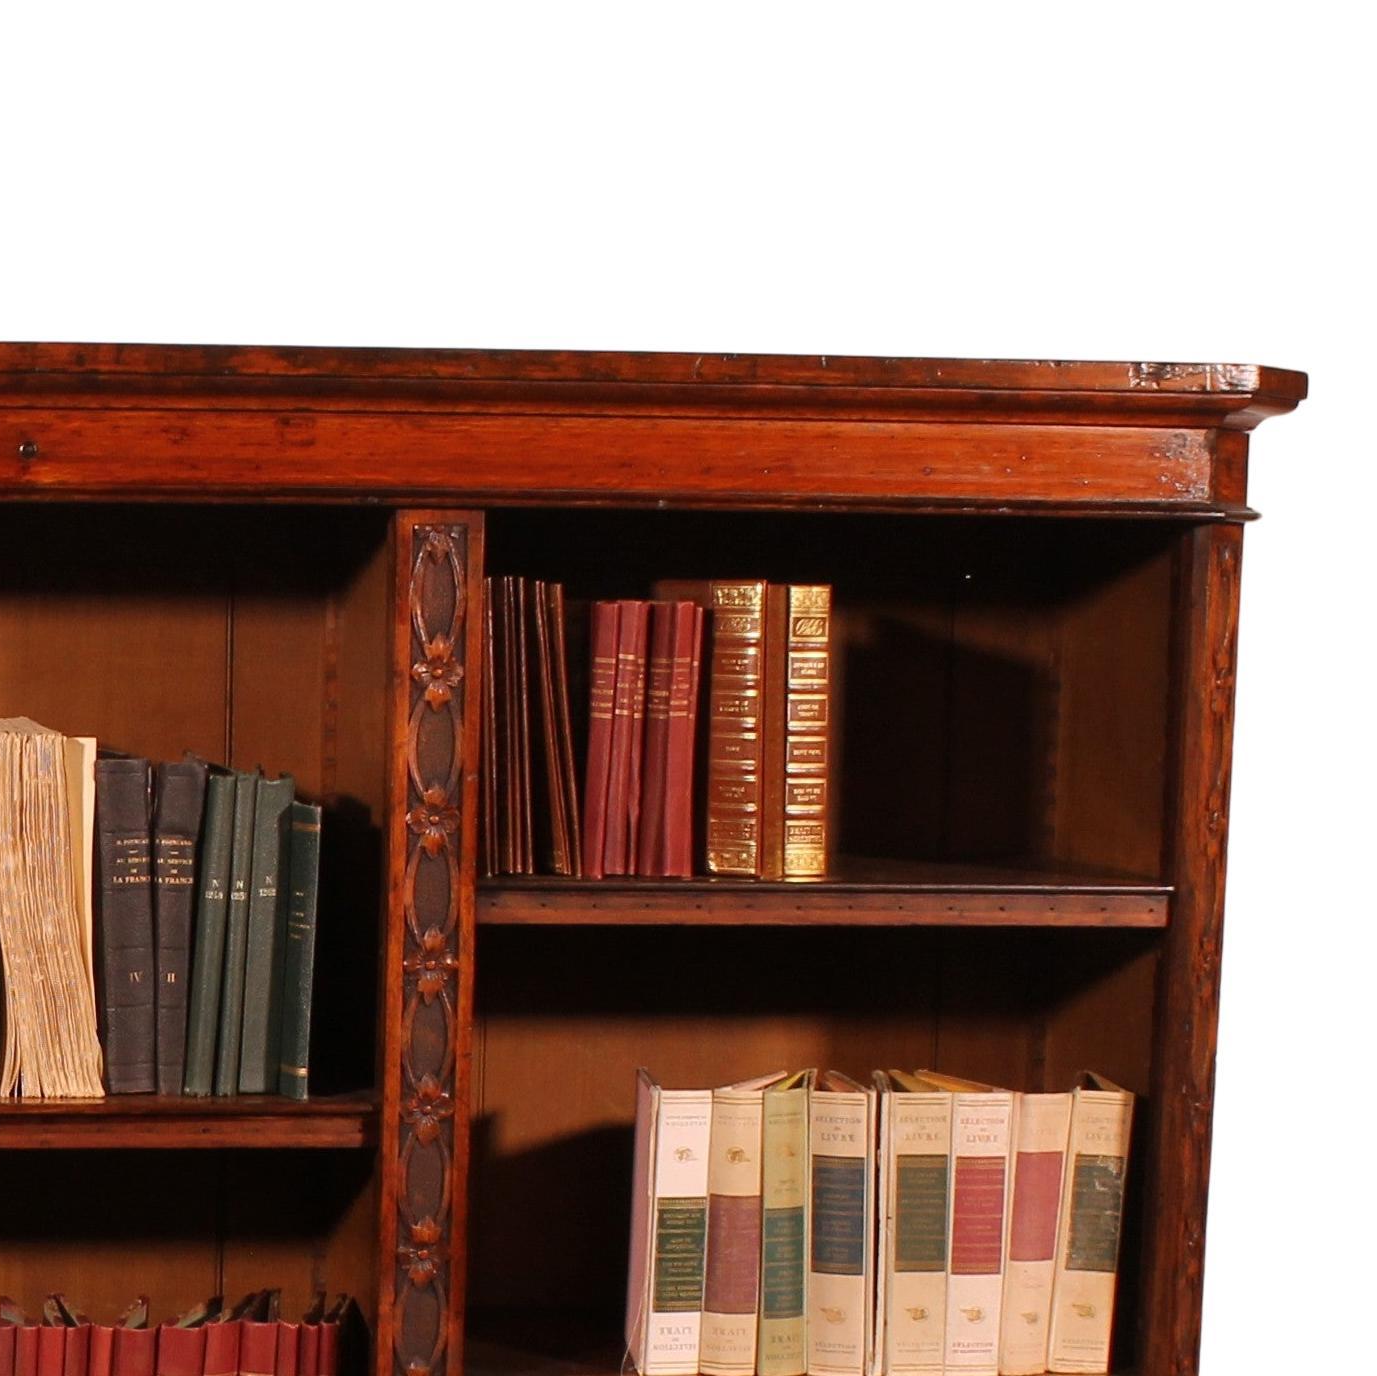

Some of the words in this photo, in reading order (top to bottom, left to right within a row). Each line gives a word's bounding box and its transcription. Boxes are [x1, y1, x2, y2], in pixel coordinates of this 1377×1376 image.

[165, 876, 194, 885] FRANCE
[235, 880, 245, 889] N
[129, 972, 143, 983] IV
